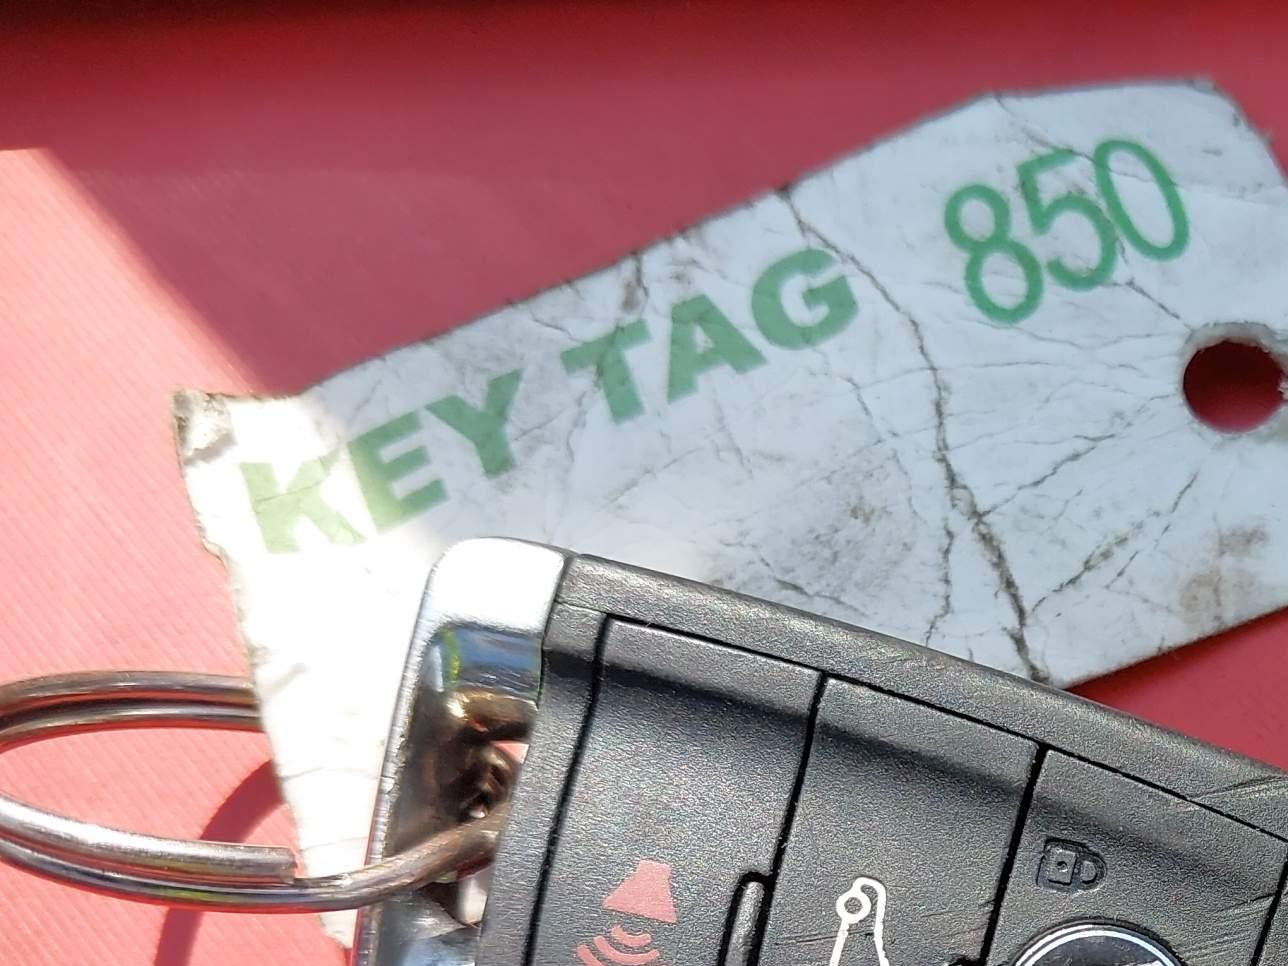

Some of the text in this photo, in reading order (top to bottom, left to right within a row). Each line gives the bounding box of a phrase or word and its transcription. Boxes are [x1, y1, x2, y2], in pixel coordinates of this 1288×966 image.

[240, 138, 1190, 554] KEY TAG 850
